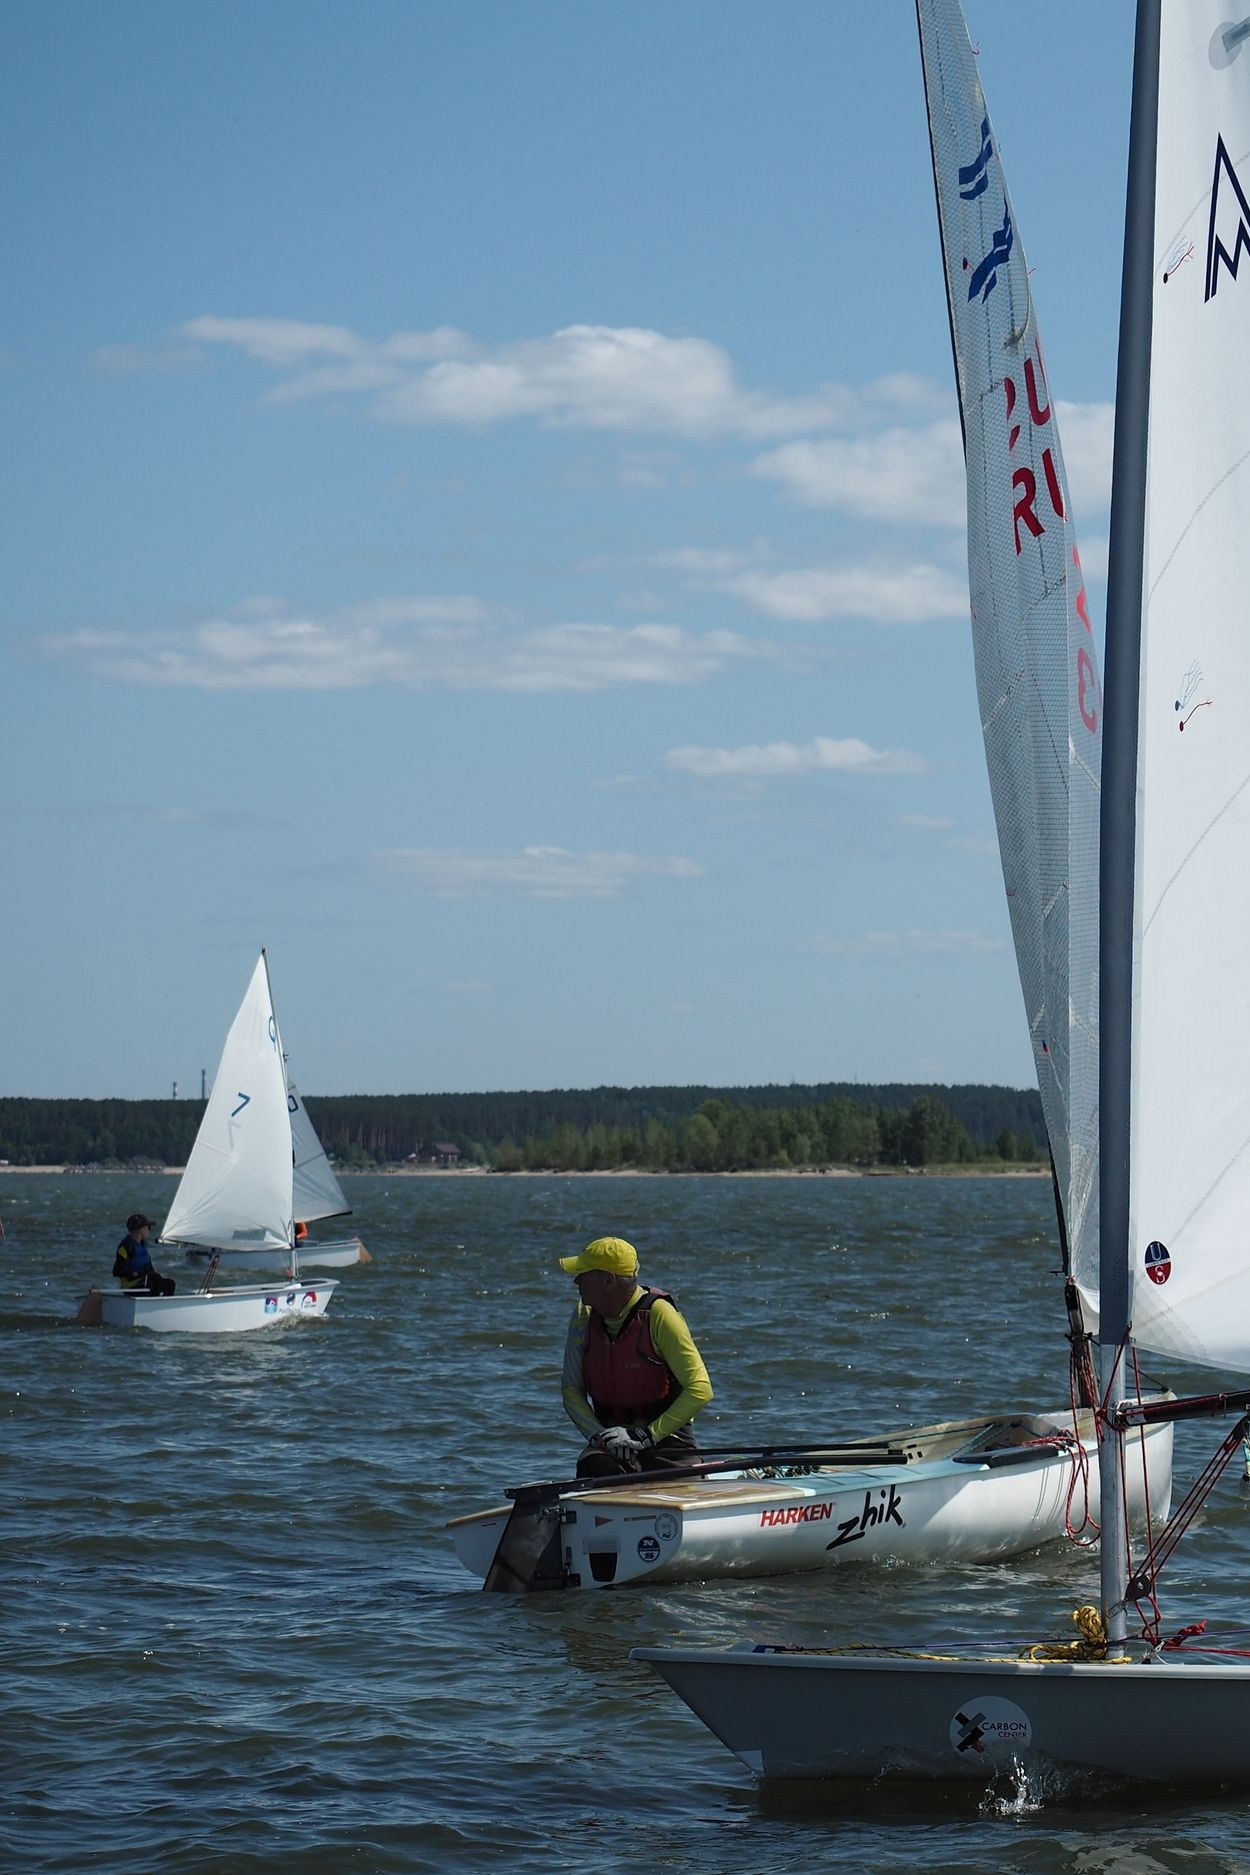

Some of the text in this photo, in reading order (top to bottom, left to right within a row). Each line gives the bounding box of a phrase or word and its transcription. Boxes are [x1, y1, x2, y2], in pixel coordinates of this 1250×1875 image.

[231, 1092, 250, 1117] 7
[760, 1502, 833, 1527] HARKEN
[826, 1484, 903, 1550] zhik
[981, 1722, 1027, 1731] CARBON
